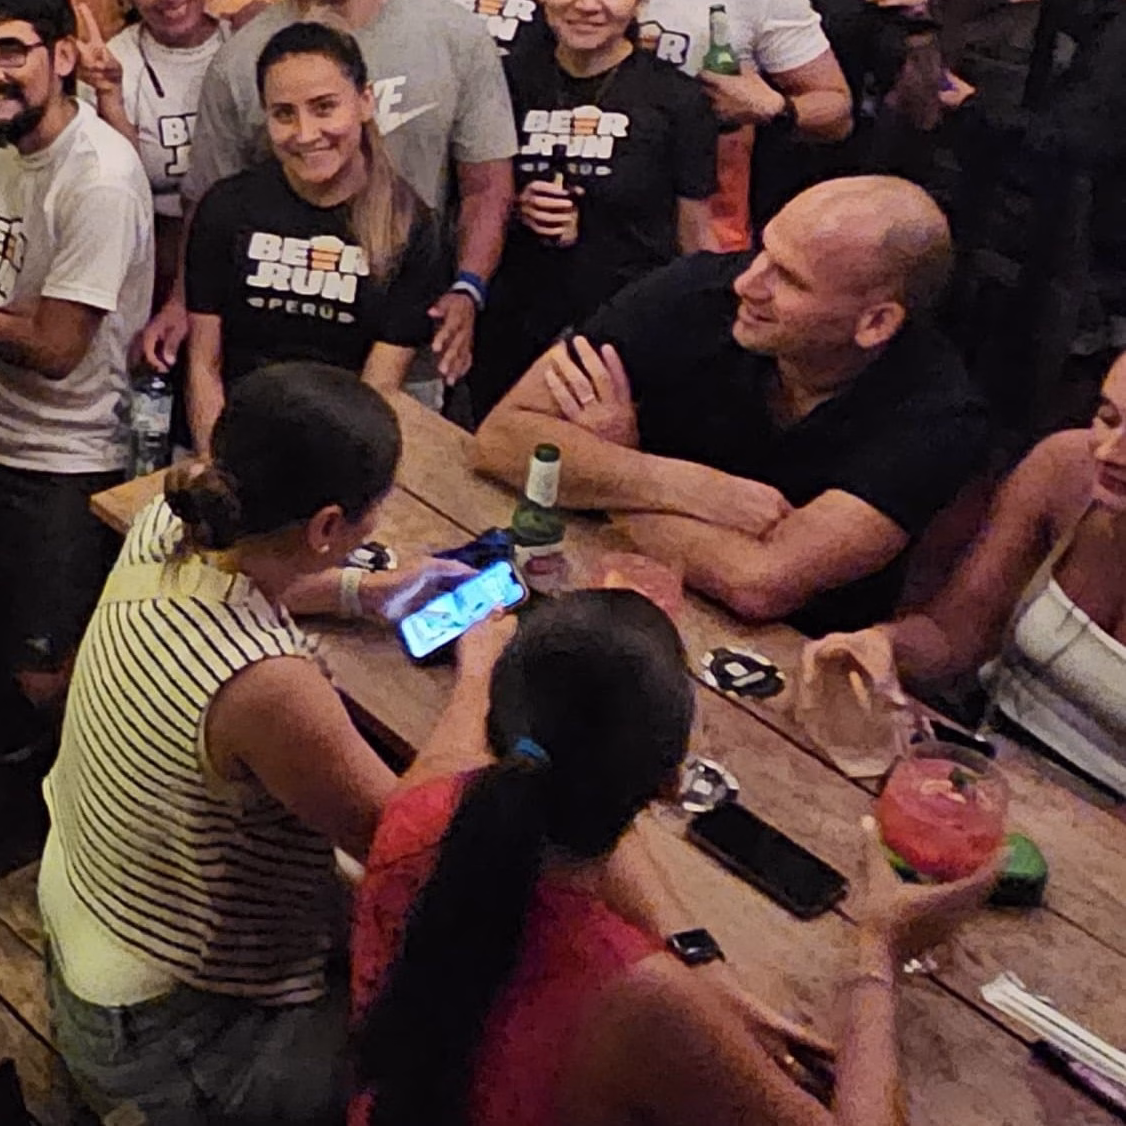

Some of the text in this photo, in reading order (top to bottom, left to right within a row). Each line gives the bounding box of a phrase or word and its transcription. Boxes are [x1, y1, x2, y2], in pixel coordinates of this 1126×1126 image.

[522, 105, 630, 138] BEER
[247, 231, 371, 277] BEER
[245, 261, 357, 304] RUN
